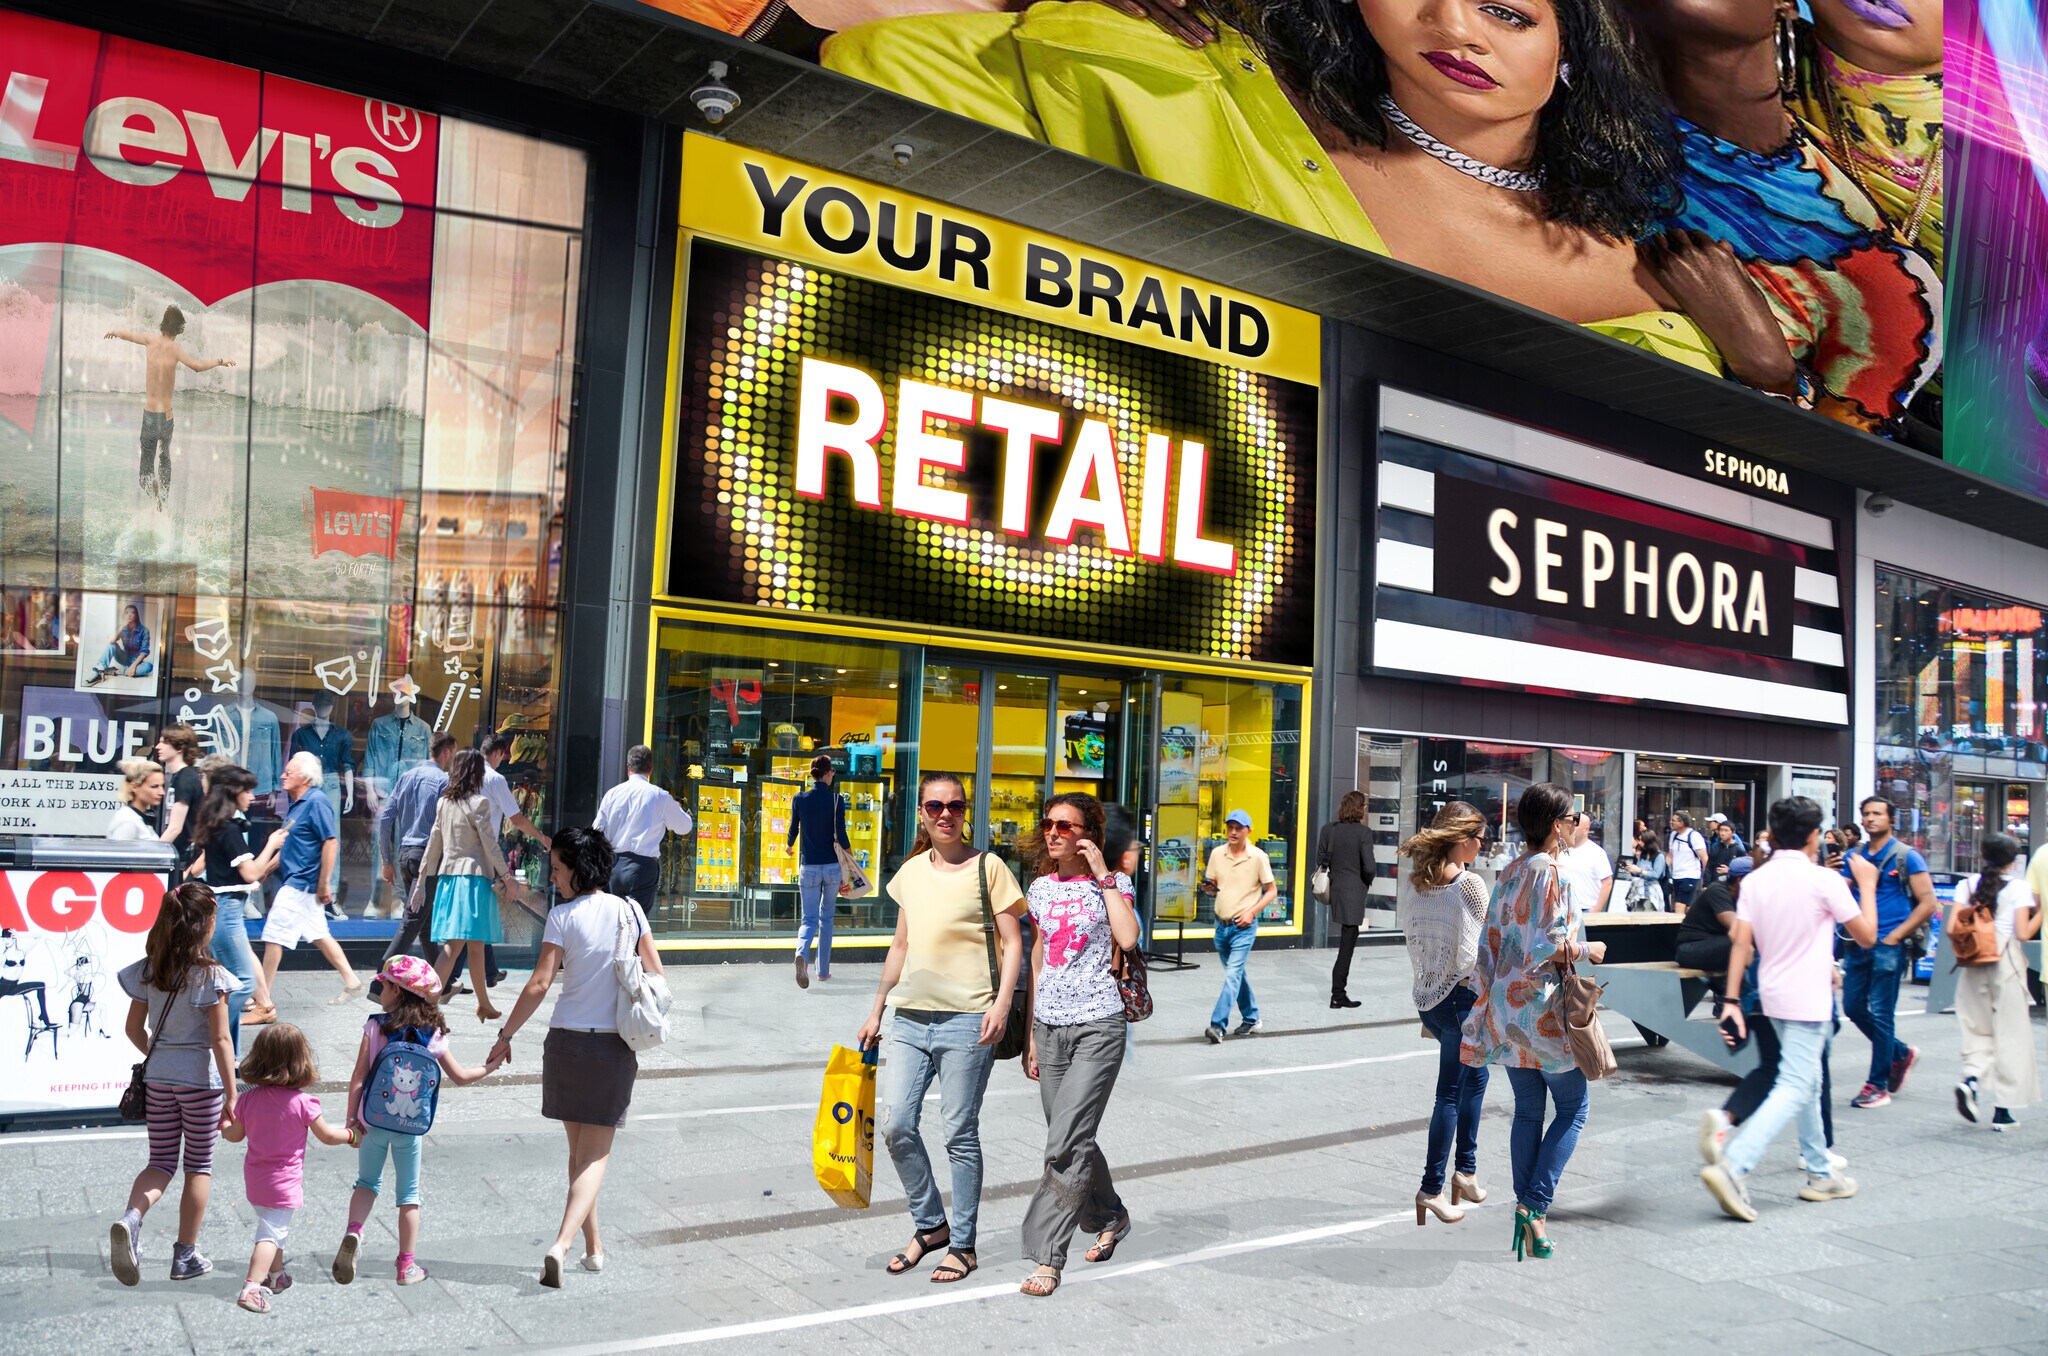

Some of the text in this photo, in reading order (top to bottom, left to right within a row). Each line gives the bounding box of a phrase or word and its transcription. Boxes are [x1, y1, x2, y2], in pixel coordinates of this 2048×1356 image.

[743, 163, 1270, 358] YOUR BRAND
[795, 357, 1238, 577] RETAIL
[1705, 449, 1789, 494] SEPHORA
[335, 562, 377, 576] GO FORTH
[1487, 508, 1769, 636] SEPHORA
[24, 715, 150, 764] BLUE
[11, 779, 119, 791] ALL THE DAYS.
[36, 799, 67, 809] AND
[51, 1083, 98, 1092] KEEPING
[103, 1082, 111, 1090] IT
